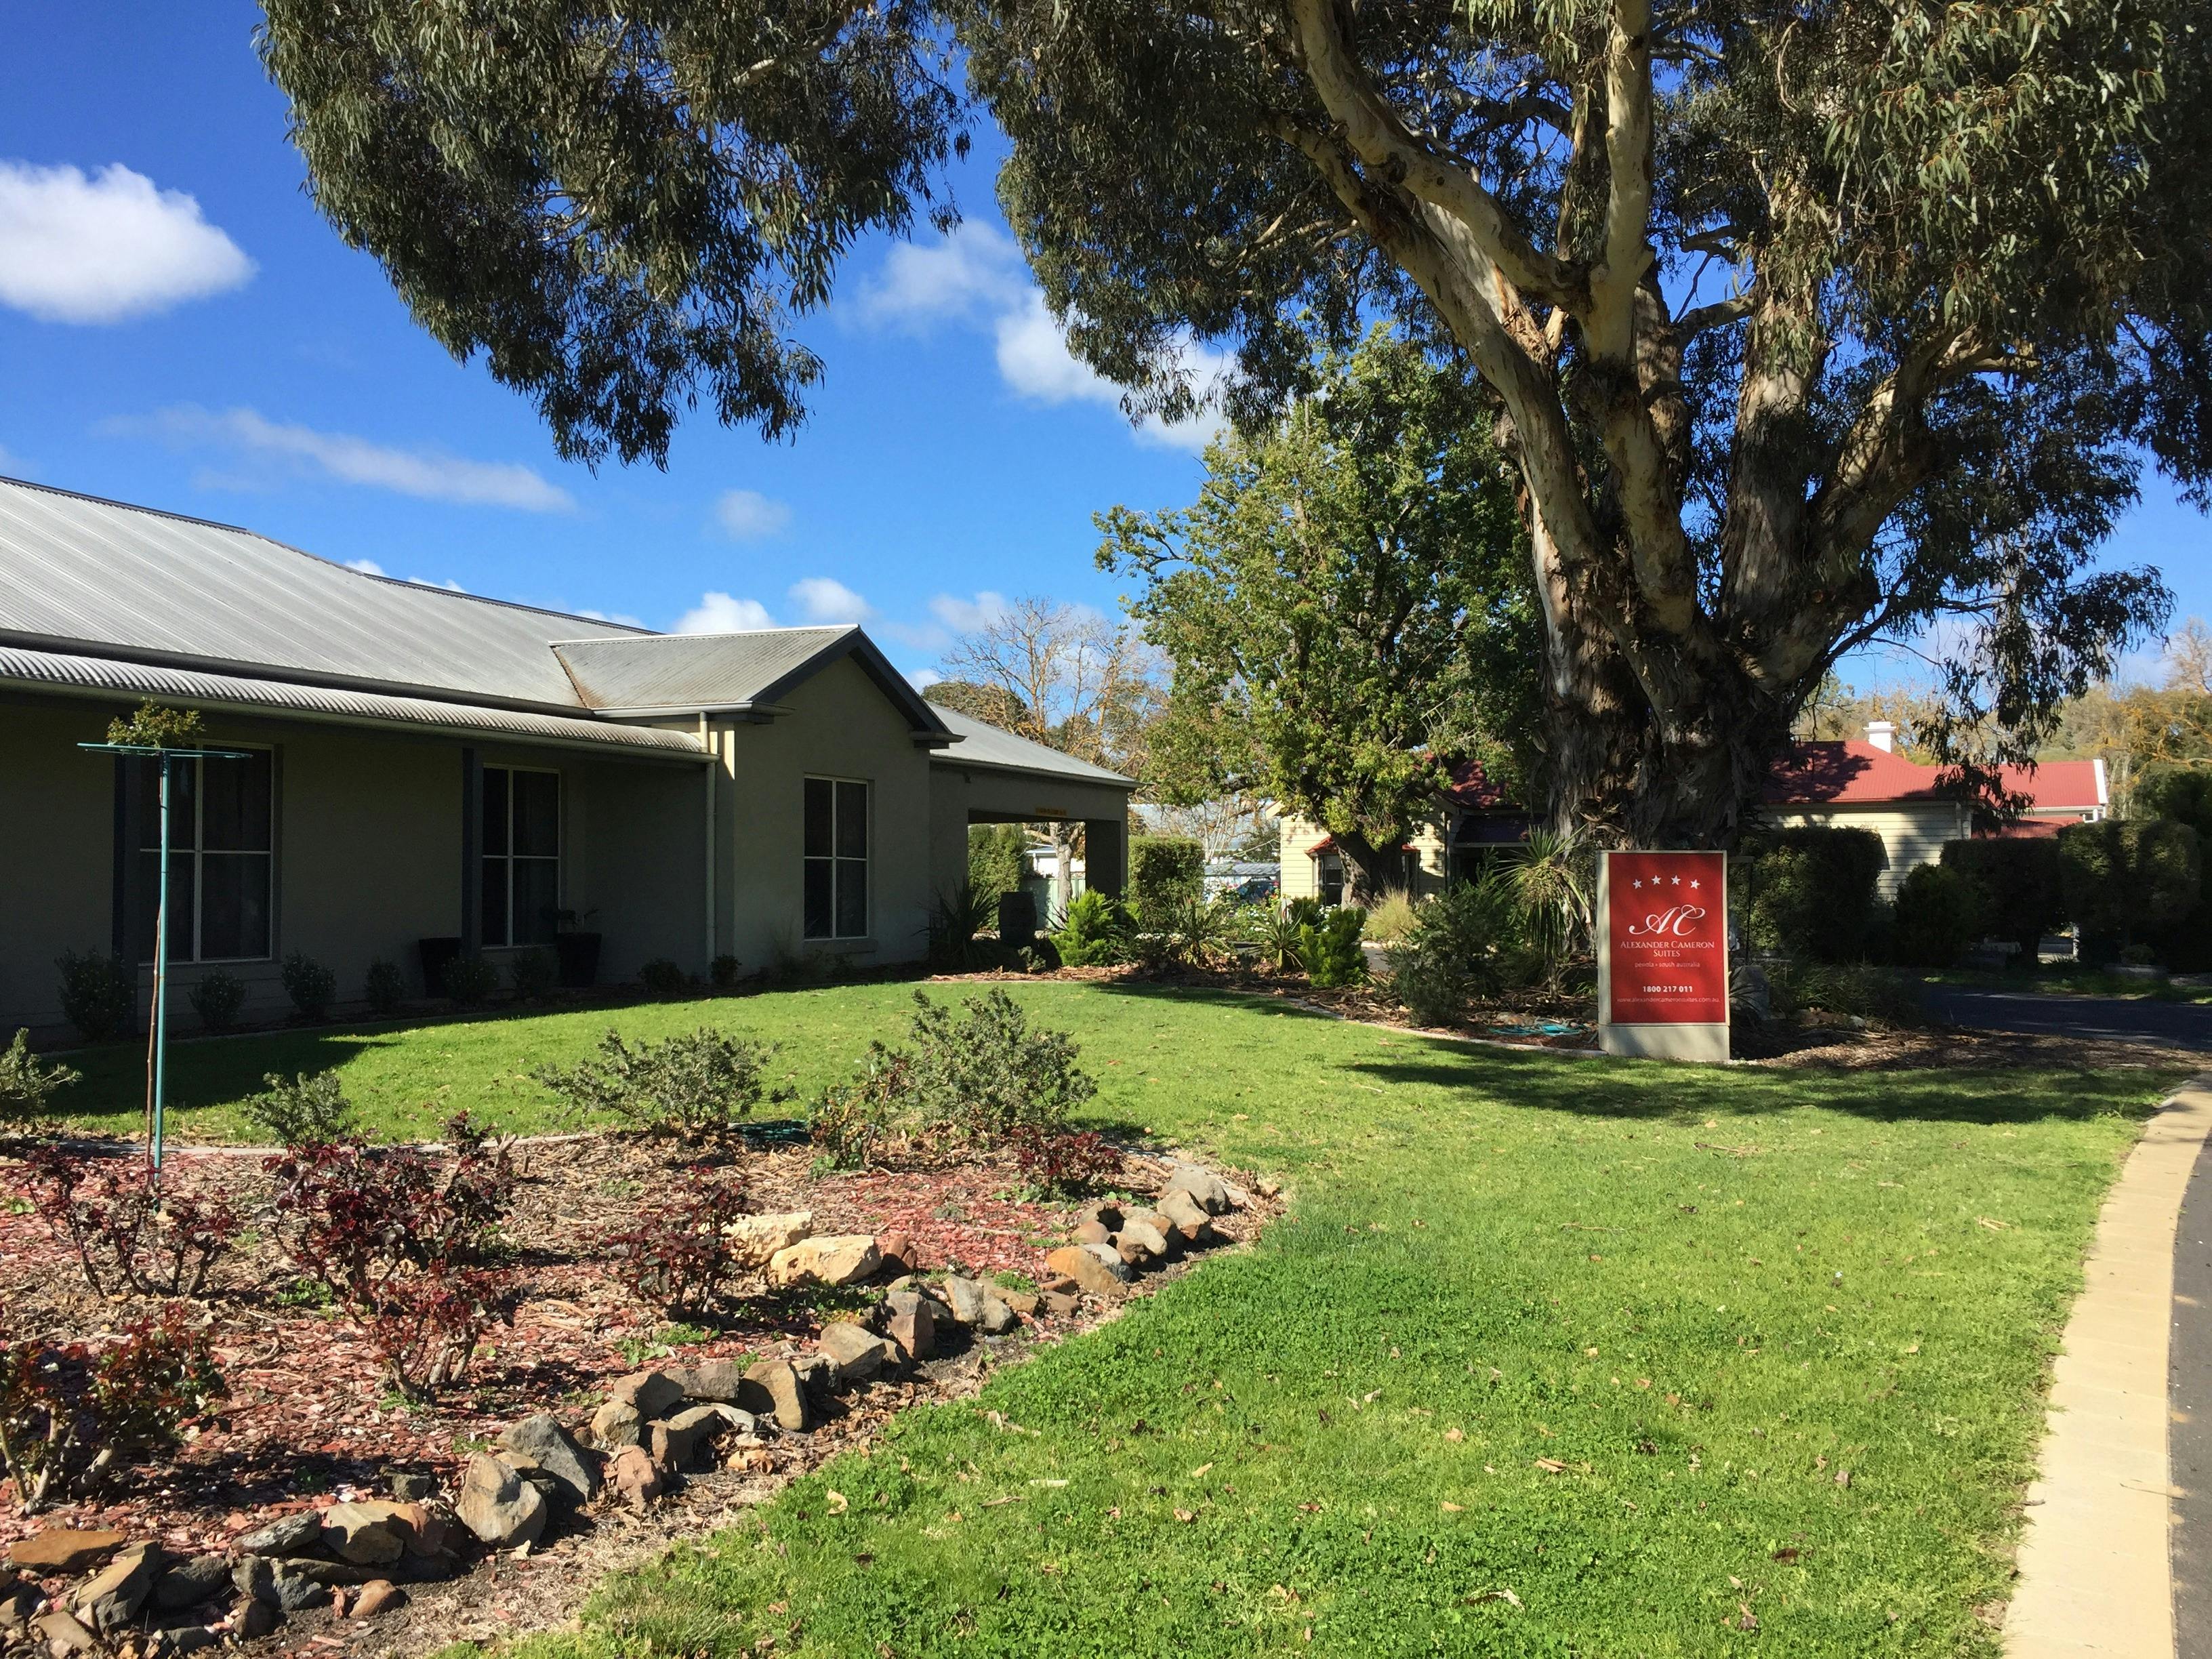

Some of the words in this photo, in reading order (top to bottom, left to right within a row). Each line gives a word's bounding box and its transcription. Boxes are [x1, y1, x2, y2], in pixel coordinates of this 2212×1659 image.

[1629, 904, 1706, 936] AC
[1620, 941, 1669, 949] ALEXANDER
[1671, 941, 1715, 949] CAMERON
